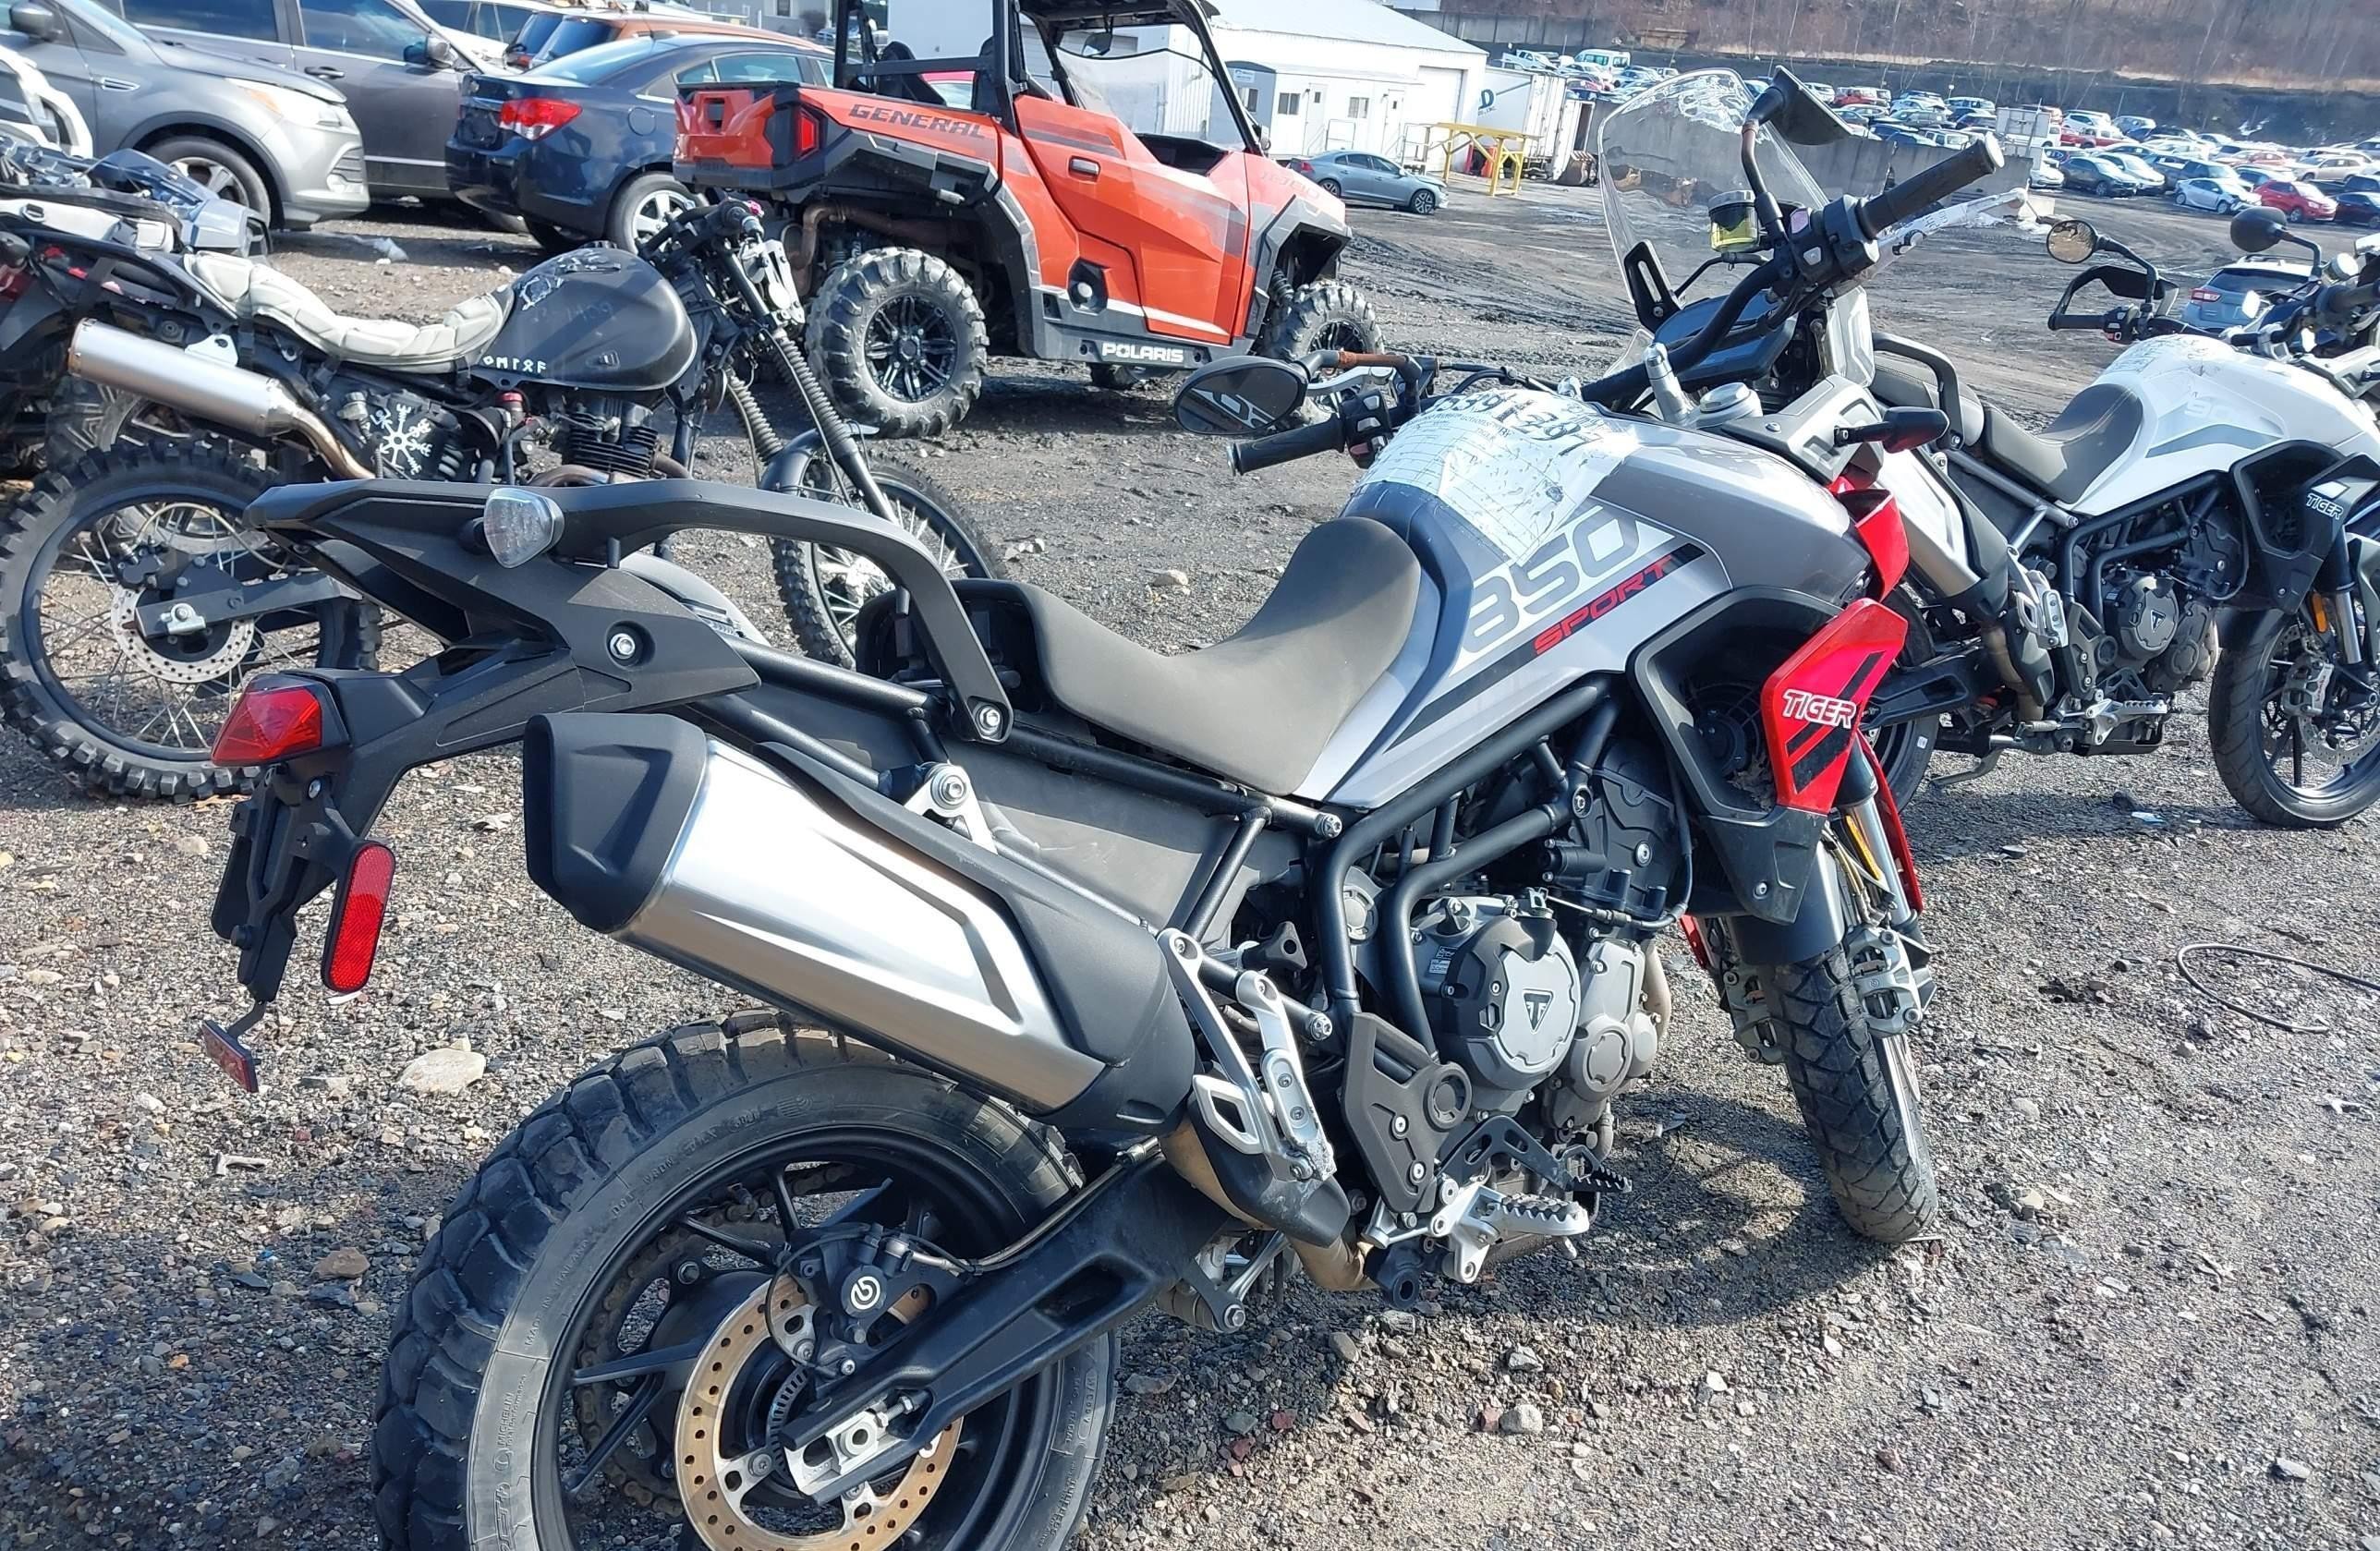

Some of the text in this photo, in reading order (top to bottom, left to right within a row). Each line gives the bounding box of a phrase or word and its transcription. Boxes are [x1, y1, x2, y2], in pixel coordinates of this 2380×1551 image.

[848, 103, 986, 139] GENERAL
[1101, 342, 1184, 363] POLARIS
[2307, 493, 2344, 520] TIGER
[1462, 509, 1640, 653] 850
[1533, 553, 1673, 656] SPORT
[1782, 688, 1857, 730] TIGER
[496, 1392, 515, 1447] MICHELIN
